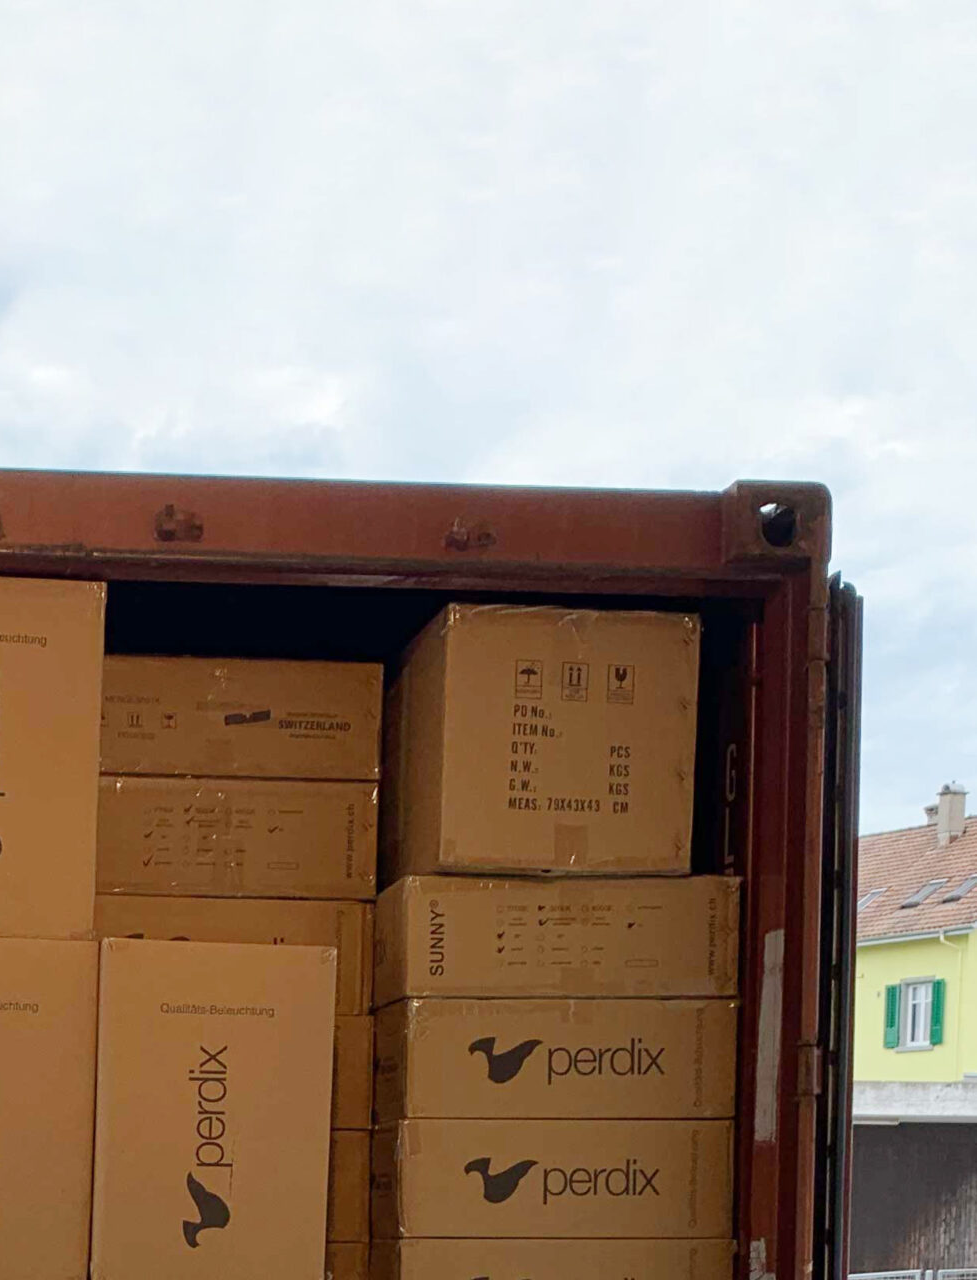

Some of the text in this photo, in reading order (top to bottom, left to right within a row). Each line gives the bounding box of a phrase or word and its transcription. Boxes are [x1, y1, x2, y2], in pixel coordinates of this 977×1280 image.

[278, 718, 352, 732] SWITZERLAND
[513, 722, 538, 736] ITEM
[610, 746, 631, 758] PCS
[609, 764, 630, 777] KGS
[609, 783, 629, 796] KGS
[547, 799, 600, 812] 79X43X43
[613, 801, 628, 814] CM
[159, 1002, 275, 1019] Qualitäts-Beleuchtung
[547, 1038, 664, 1085] perdix
[187, 1046, 233, 1169] perdix
[542, 1159, 659, 1205] perdix
